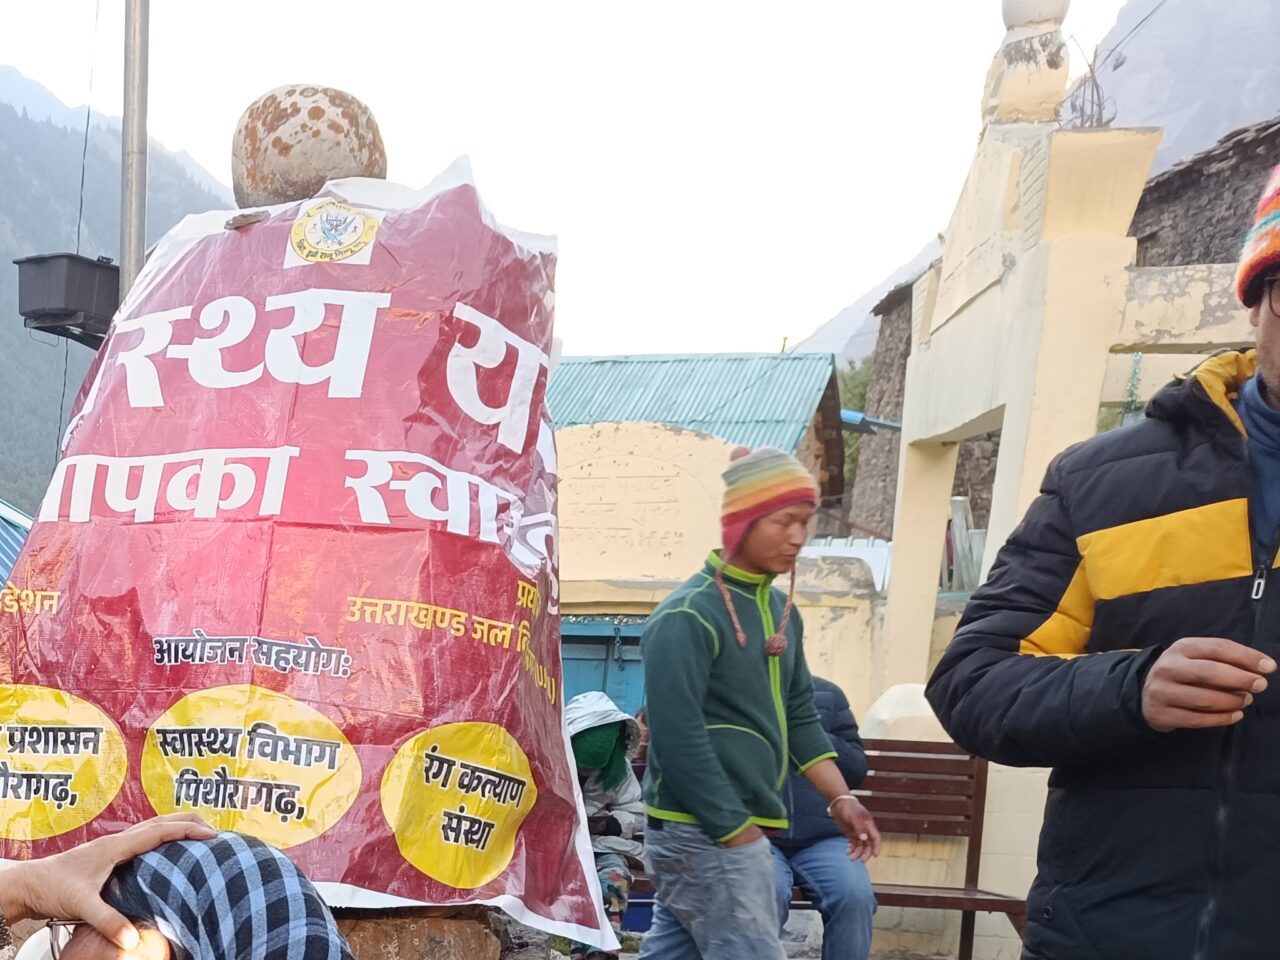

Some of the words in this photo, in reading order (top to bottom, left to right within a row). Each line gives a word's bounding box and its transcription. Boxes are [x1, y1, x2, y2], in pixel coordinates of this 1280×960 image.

[346, 592, 468, 637] उत्तराखण्ड
[472, 615, 514, 650] जल
[154, 630, 244, 665] आयोजन
[7, 726, 104, 755] प्रशासन
[156, 726, 241, 759] स्वास्थ्य
[248, 723, 340, 770] विभाग
[423, 749, 452, 788] रंग
[457, 762, 526, 810] कल्याण
[441, 807, 494, 851] संस्था
